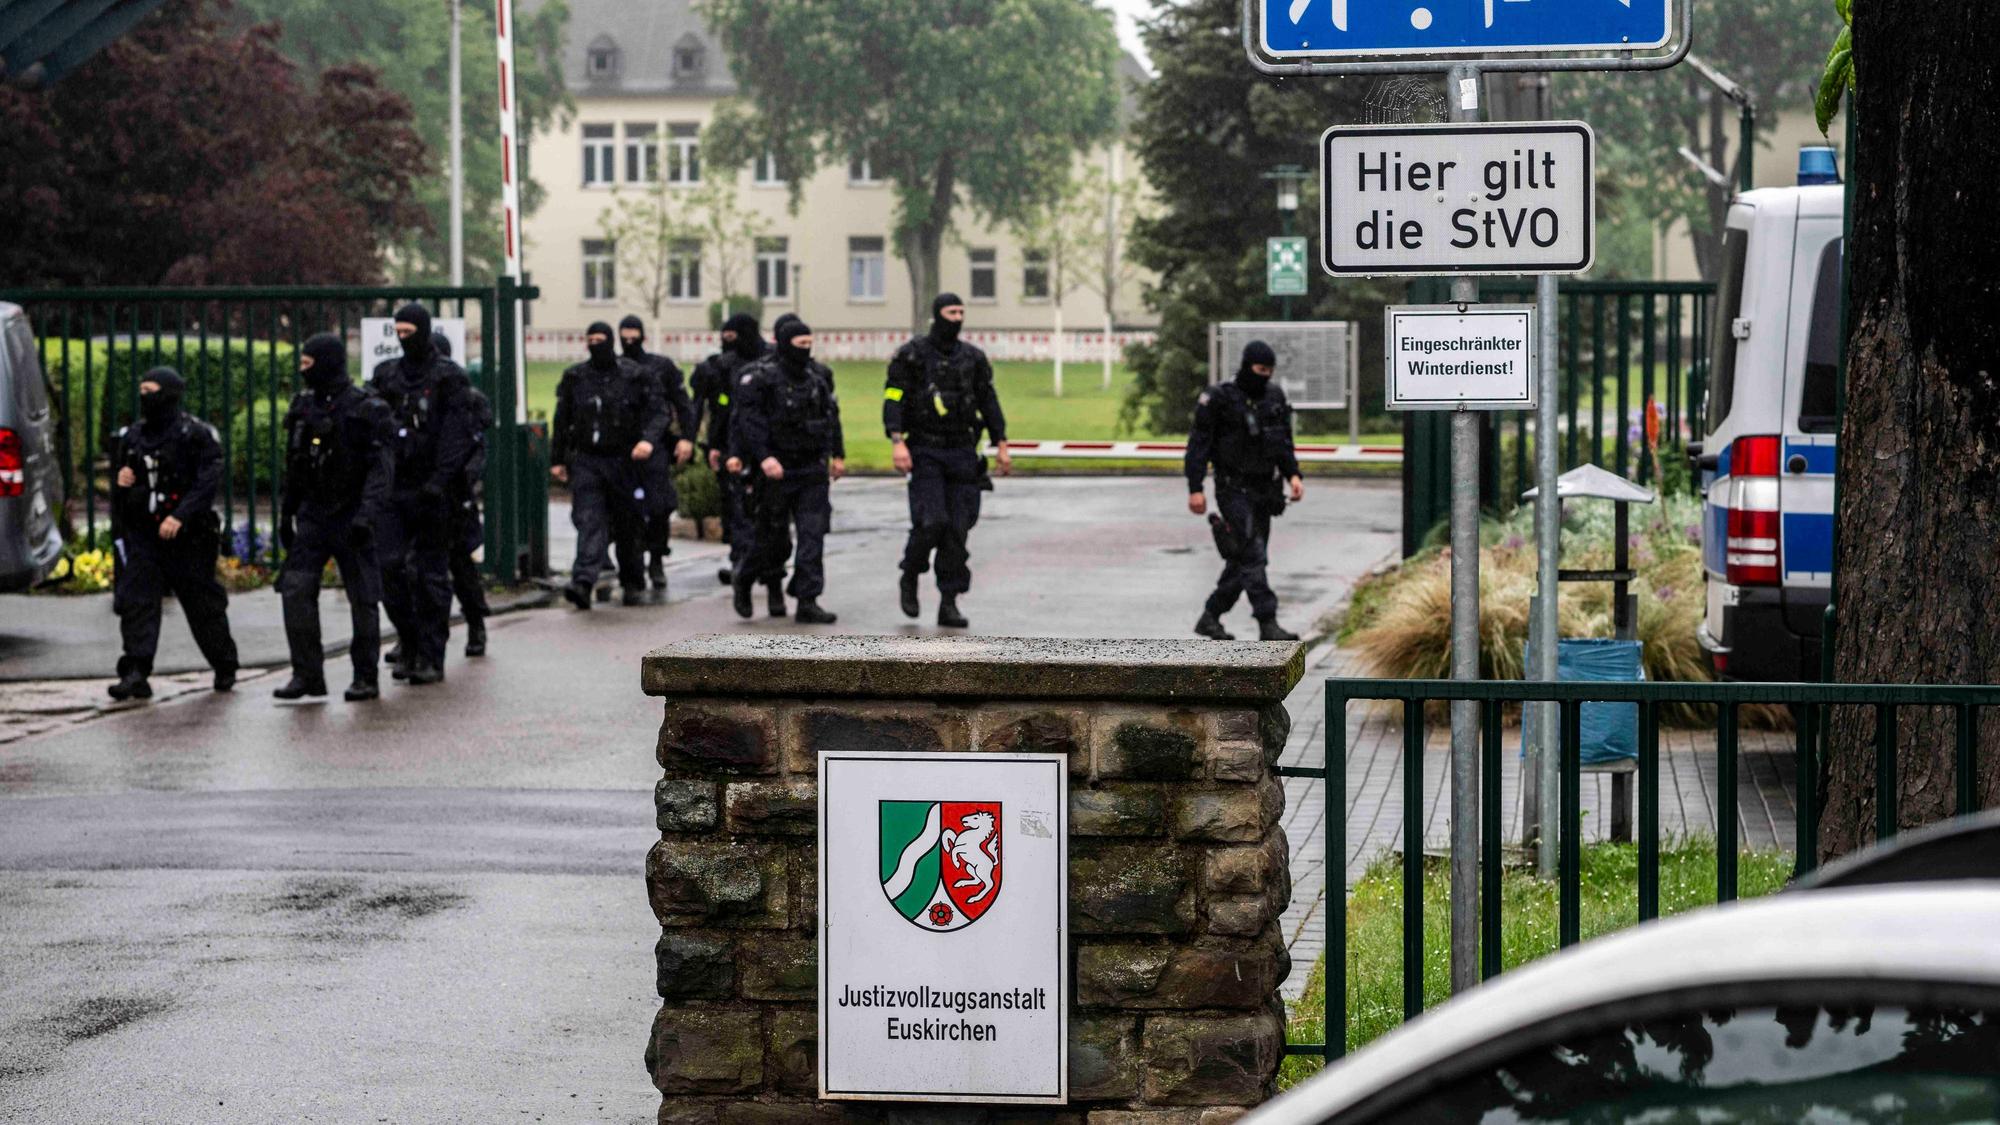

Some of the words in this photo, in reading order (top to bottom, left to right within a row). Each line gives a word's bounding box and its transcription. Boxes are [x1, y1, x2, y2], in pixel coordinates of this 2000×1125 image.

[1358, 151, 1457, 192] Hier
[1483, 149, 1556, 202] gilt
[1355, 209, 1423, 250] die
[1449, 207, 1559, 249] StVO
[1401, 336, 1522, 355] Eingeschränkter
[1407, 360, 1514, 376] Winterdienst!
[838, 984, 1046, 1013] Justizvollzugsanstalt
[887, 1017, 997, 1042] Euskirchen
